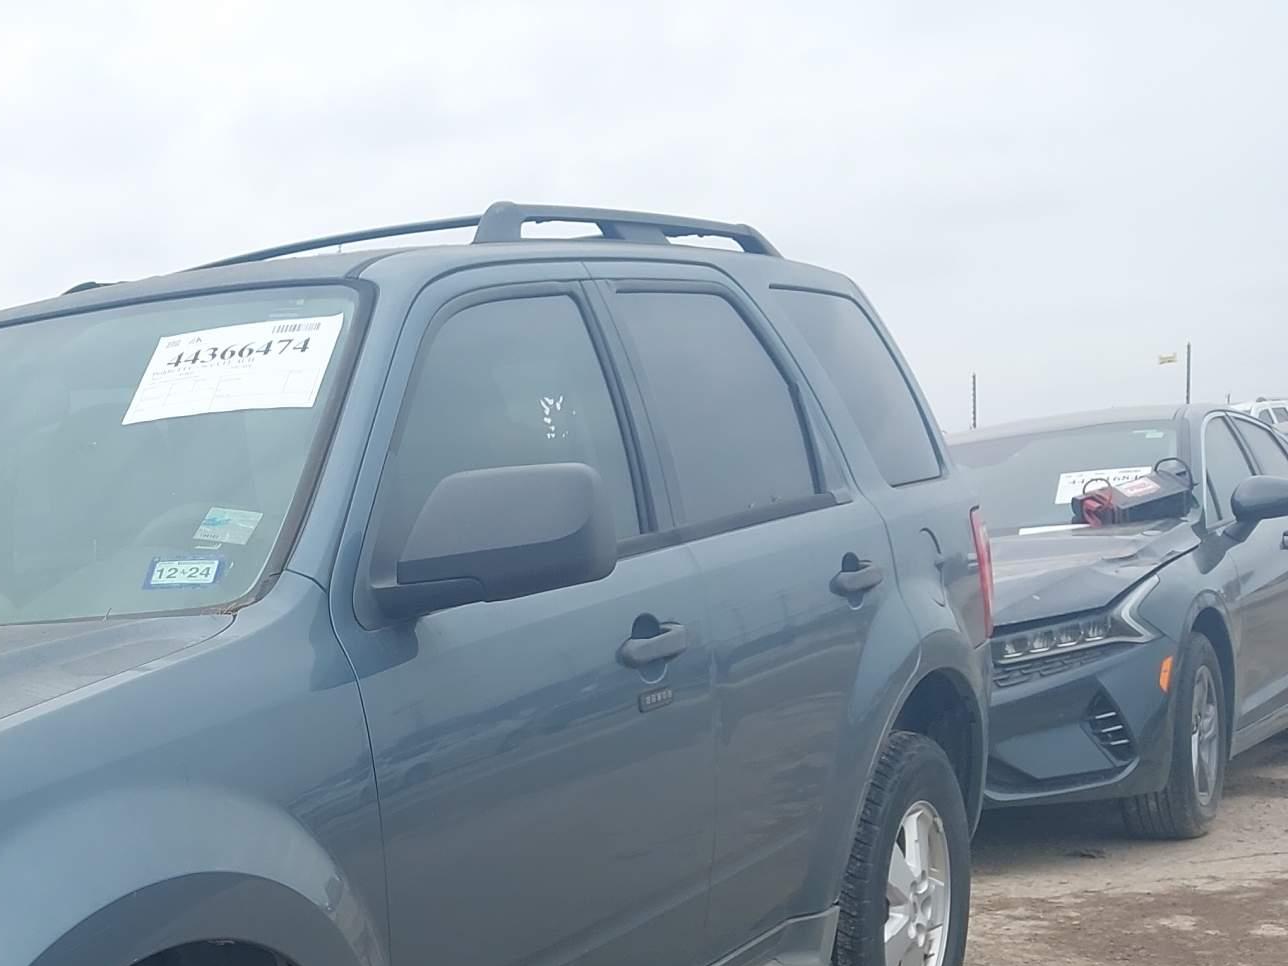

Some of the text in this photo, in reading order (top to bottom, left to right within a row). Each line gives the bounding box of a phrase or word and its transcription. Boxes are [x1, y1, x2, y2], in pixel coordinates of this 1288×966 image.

[166, 336, 311, 368] 44366474
[155, 566, 211, 579] 12 24
